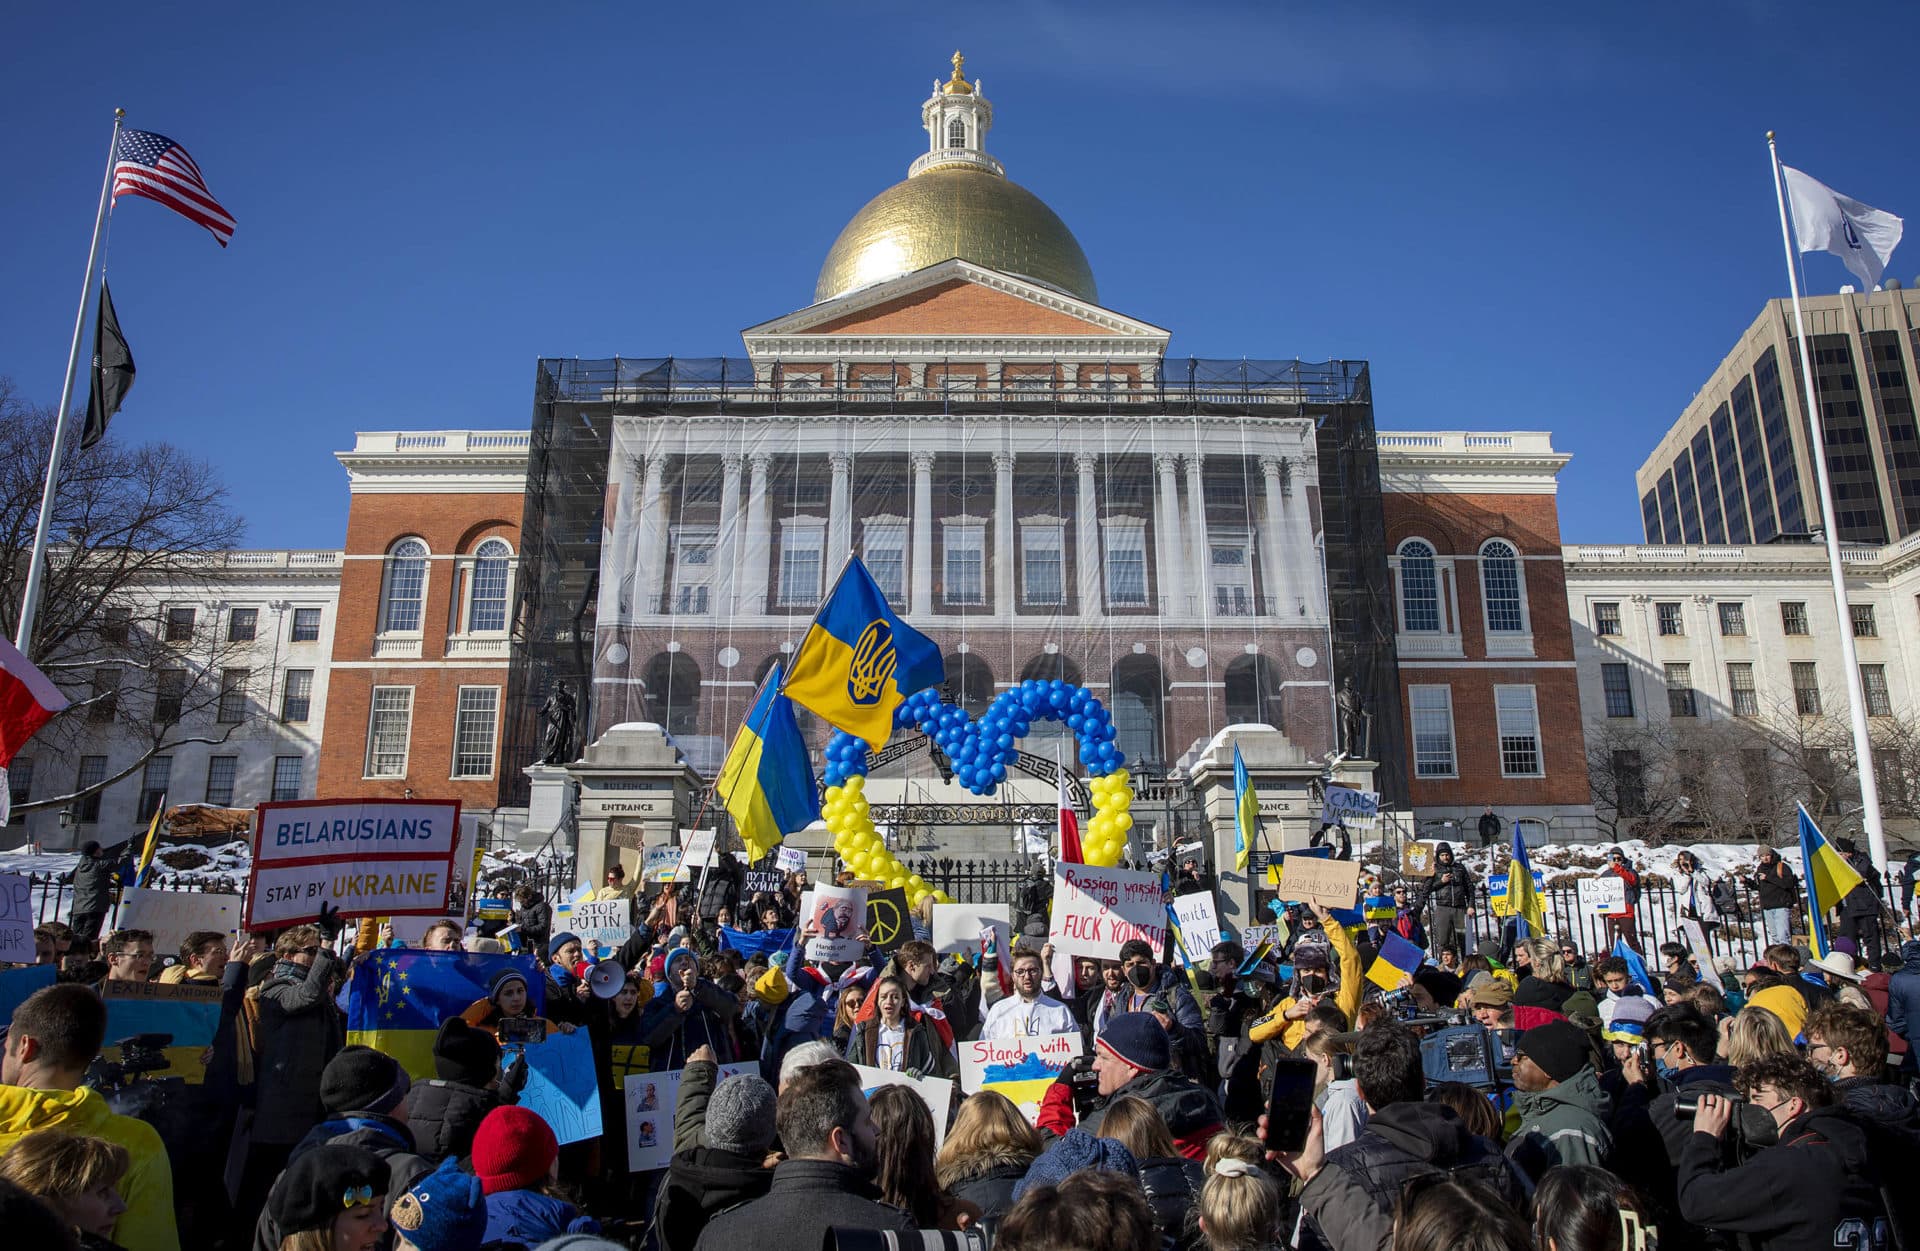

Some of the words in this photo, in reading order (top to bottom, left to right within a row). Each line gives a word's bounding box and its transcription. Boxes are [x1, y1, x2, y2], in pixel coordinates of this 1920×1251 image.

[601, 803, 654, 812] ENTRANCE
[1258, 803, 1290, 811] RANCE
[276, 819, 432, 847] BELARUSIANS
[650, 850, 681, 860] NATO
[746, 872, 779, 882] ПУТІН
[1065, 869, 1118, 893] Russian
[1123, 880, 1162, 897] warshi
[266, 883, 302, 903] STAY
[307, 881, 326, 898] BY
[332, 873, 438, 899] UKRAINE
[579, 901, 618, 916] STOP
[1100, 894, 1118, 915] go
[1180, 902, 1210, 923] with
[569, 913, 621, 930] PUTIN
[1063, 915, 1102, 942] FUCK
[815, 943, 836, 951] Hands
[1182, 928, 1217, 957] AINE
[973, 1039, 1024, 1063] Stand
[1040, 1037, 1071, 1053] with
